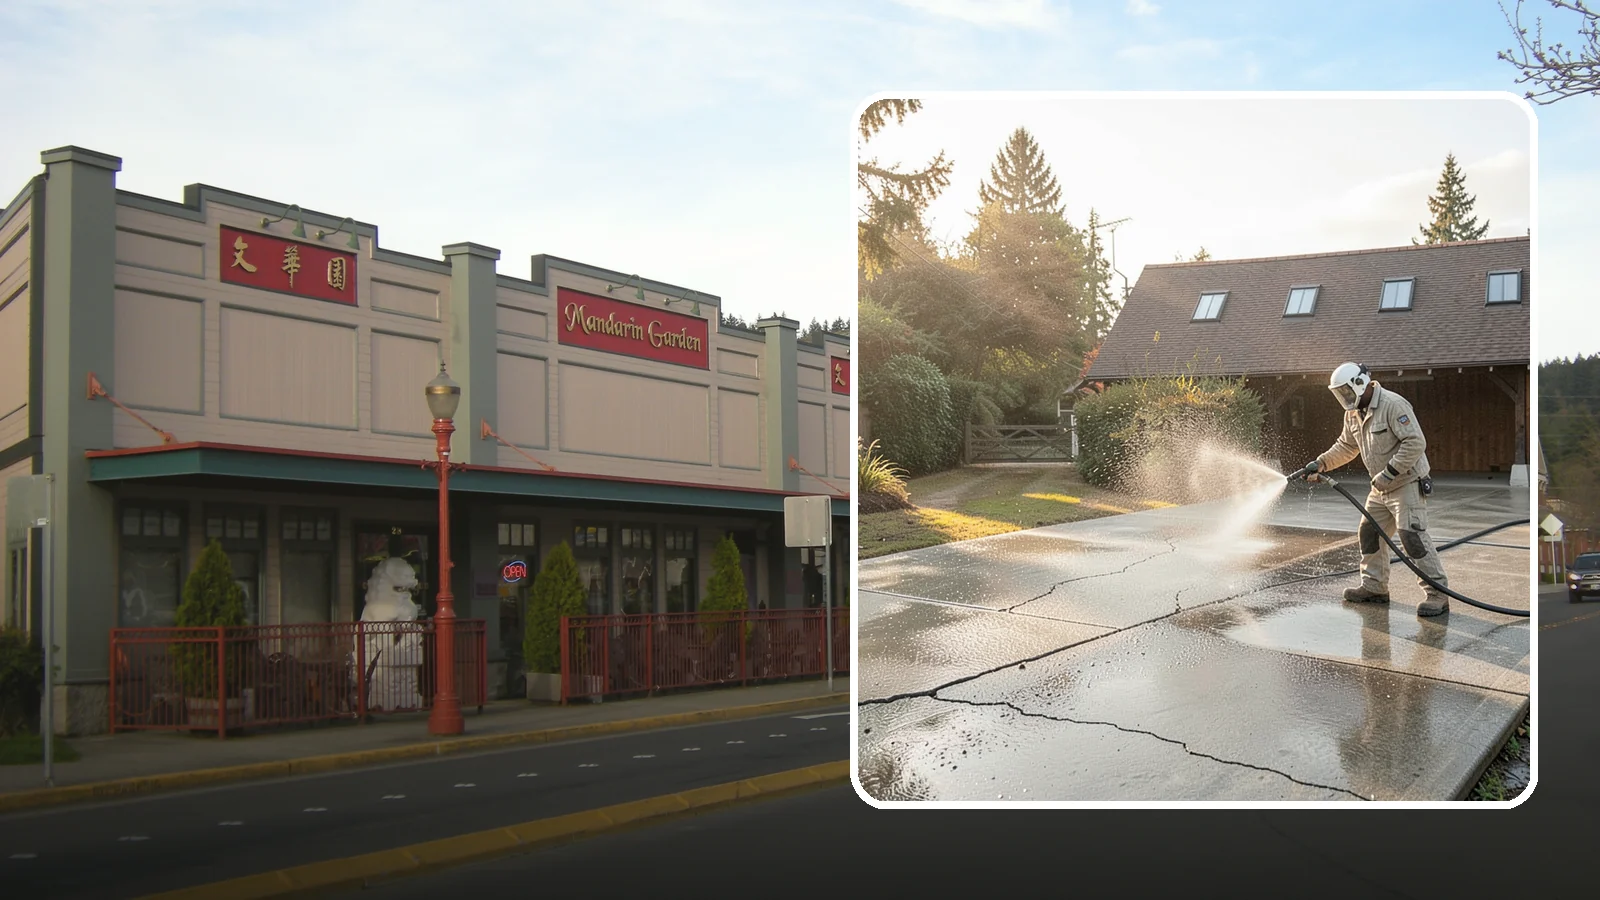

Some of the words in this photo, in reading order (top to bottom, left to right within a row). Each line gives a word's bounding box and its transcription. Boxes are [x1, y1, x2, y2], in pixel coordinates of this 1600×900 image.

[231, 236, 346, 291] 文華園
[564, 302, 644, 341] Mandarin
[648, 320, 701, 352] Garden
[834, 363, 846, 386] 文
[503, 565, 527, 578] OPEN
